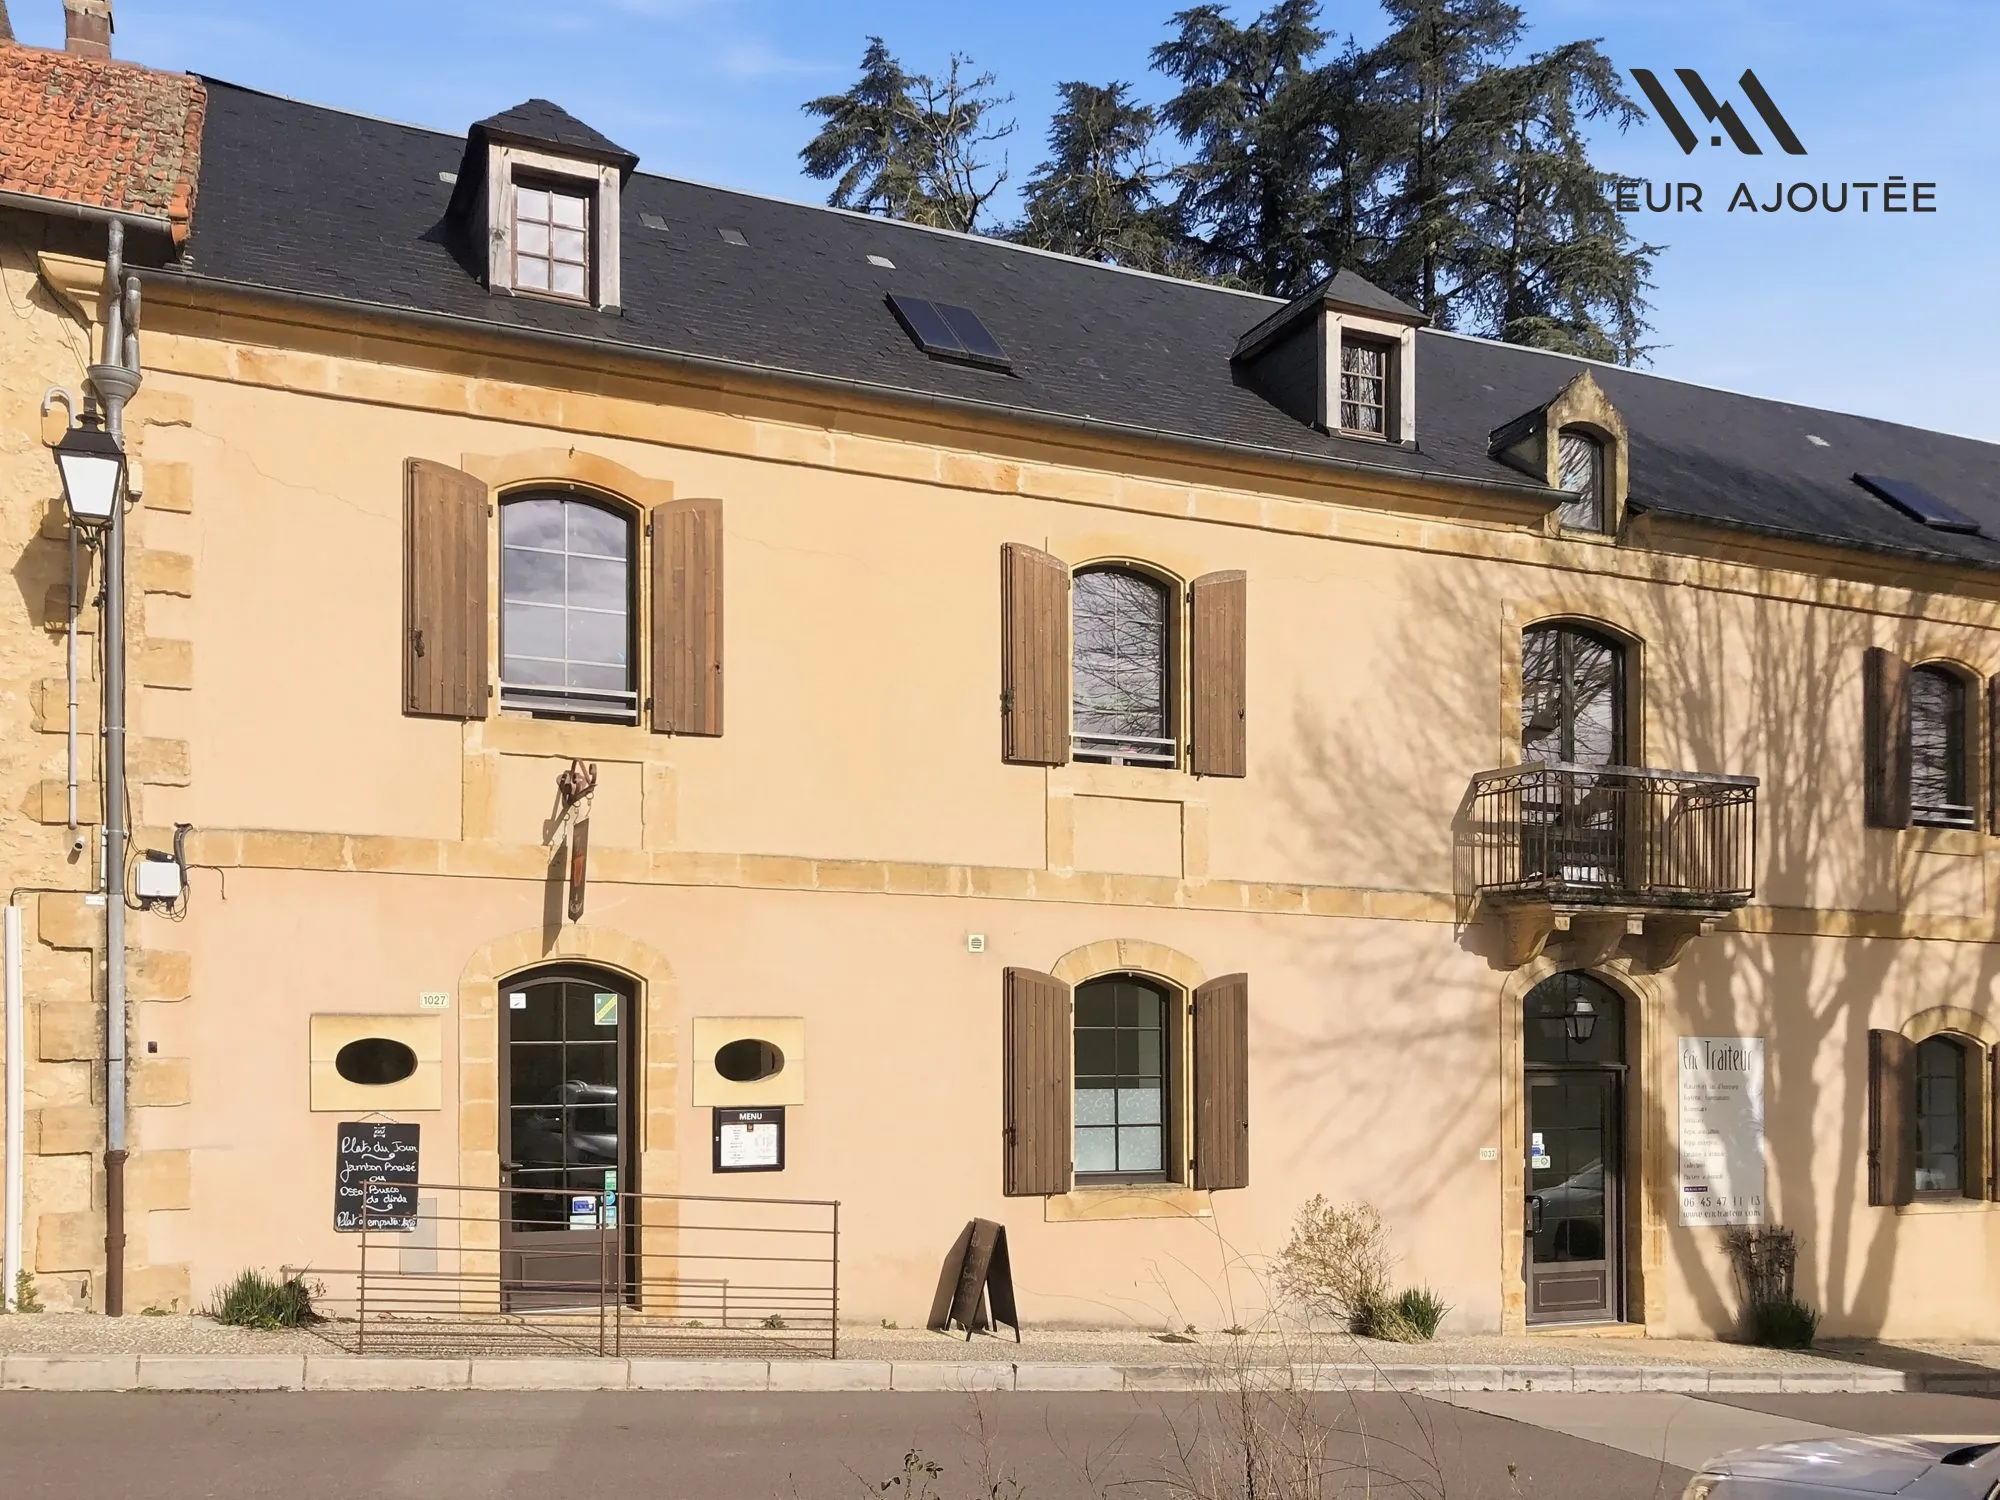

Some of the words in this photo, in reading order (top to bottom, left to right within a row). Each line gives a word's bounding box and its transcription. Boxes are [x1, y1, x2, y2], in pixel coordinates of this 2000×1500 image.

[424, 995, 446, 1005] 1027
[1683, 1049, 1699, 1071] Eric
[1704, 1040, 1753, 1072] Traiteur
[739, 1112, 763, 1121] MENU
[373, 1141, 390, 1153] du
[391, 1140, 418, 1153] Jour
[340, 1160, 382, 1183] Jambon
[1683, 1196, 1695, 1208] 06
[1700, 1196, 1712, 1208] 45
[1716, 1196, 1727, 1207] 47
[1733, 1194, 1743, 1206] 11
[1750, 1194, 1761, 1206] 13
